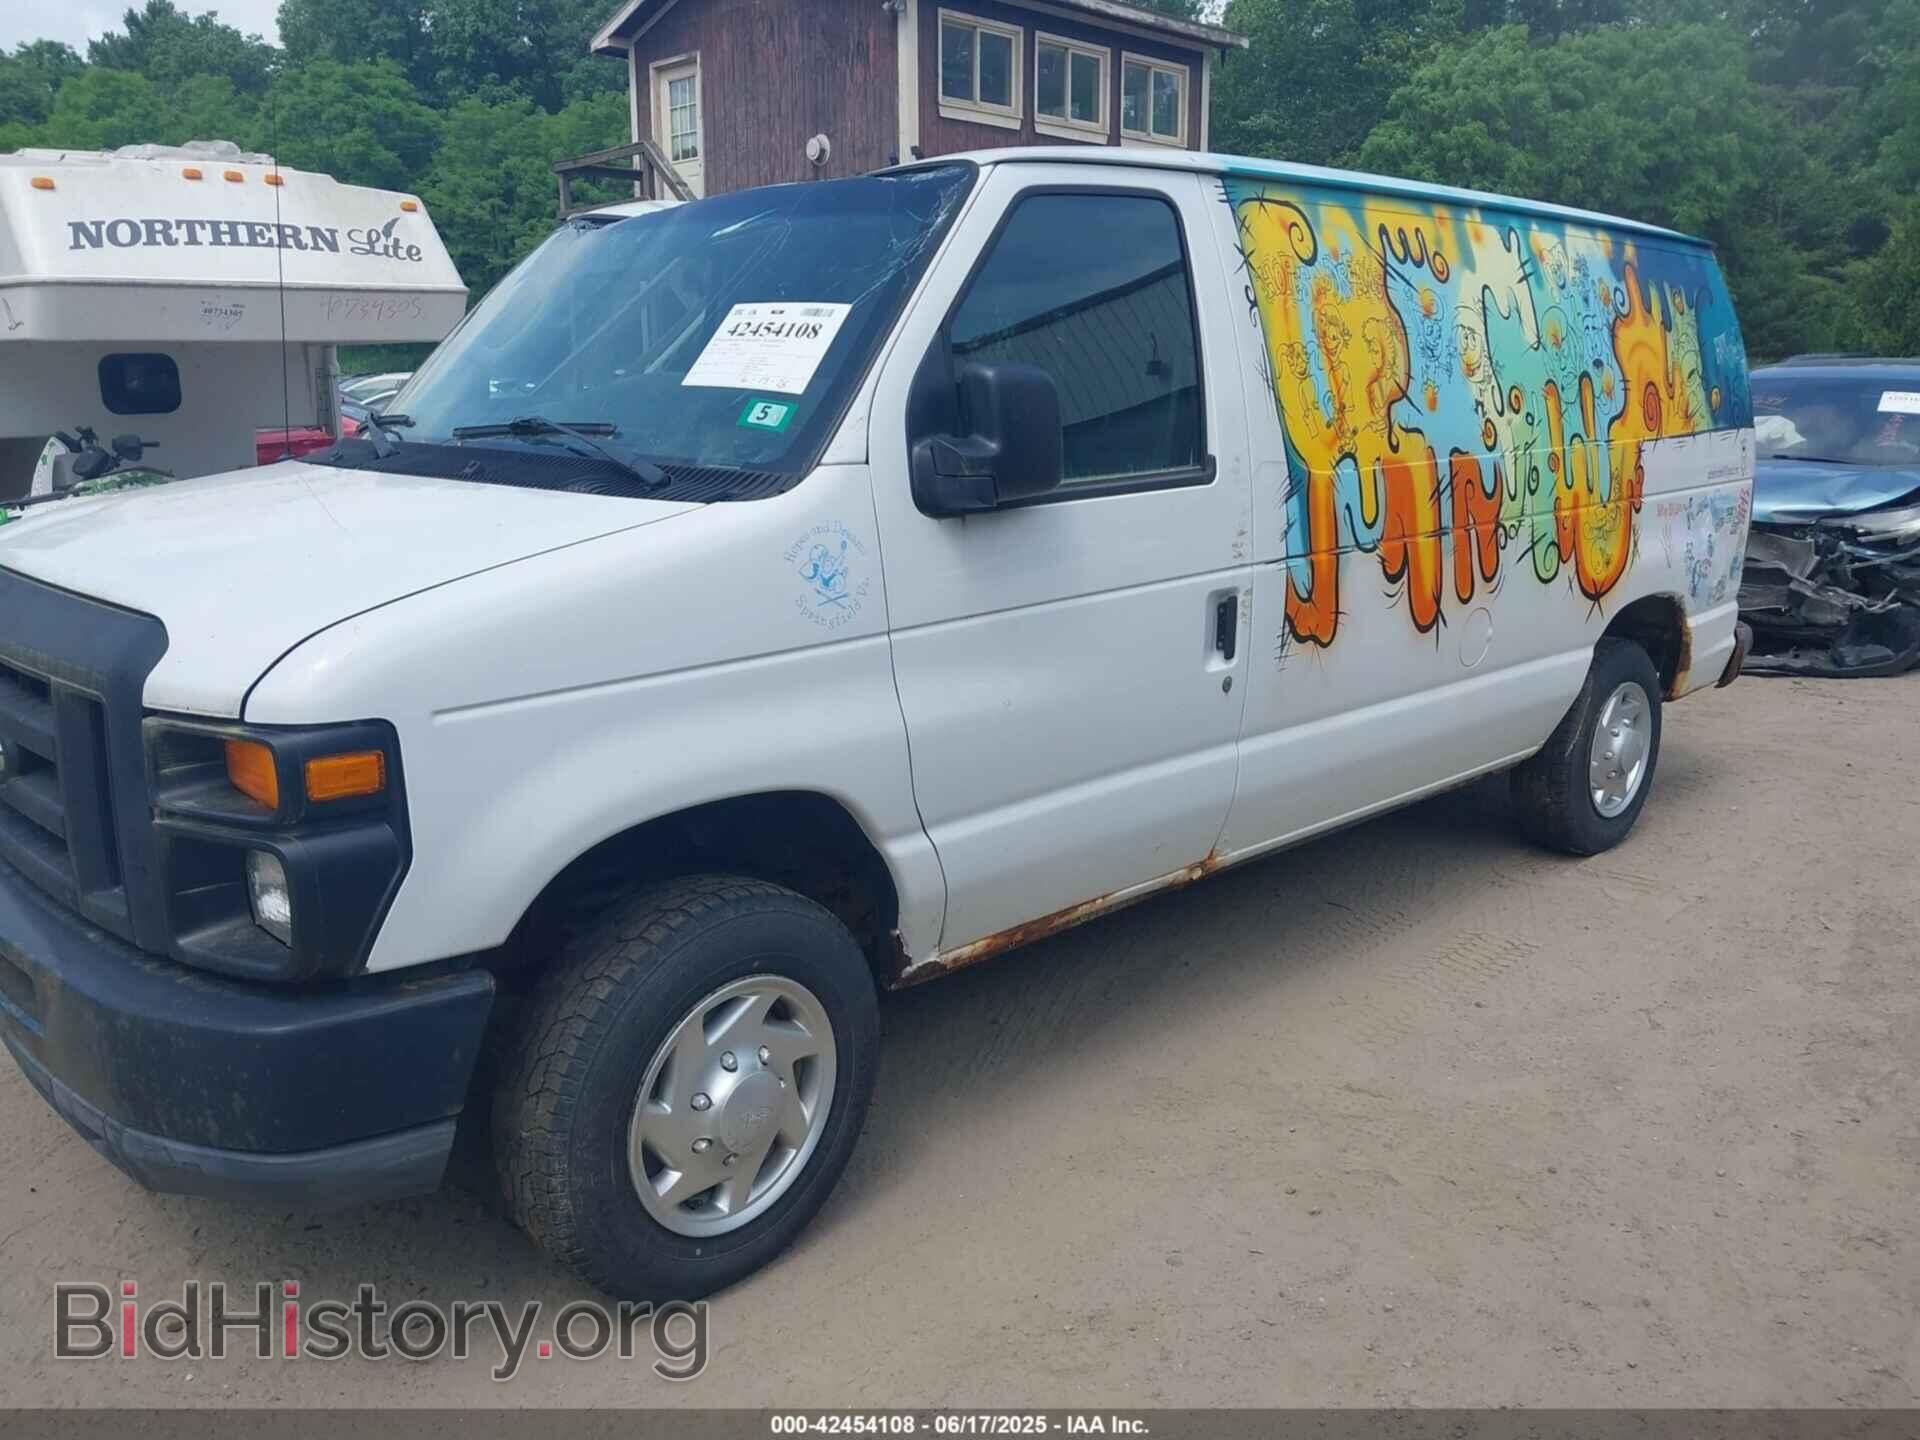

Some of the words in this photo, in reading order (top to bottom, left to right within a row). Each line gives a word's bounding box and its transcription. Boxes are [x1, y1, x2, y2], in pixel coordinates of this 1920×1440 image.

[68, 219, 340, 253] NORTHERN
[347, 217, 423, 262] Lite
[727, 321, 823, 340] 42454108
[756, 405, 771, 421] 5
